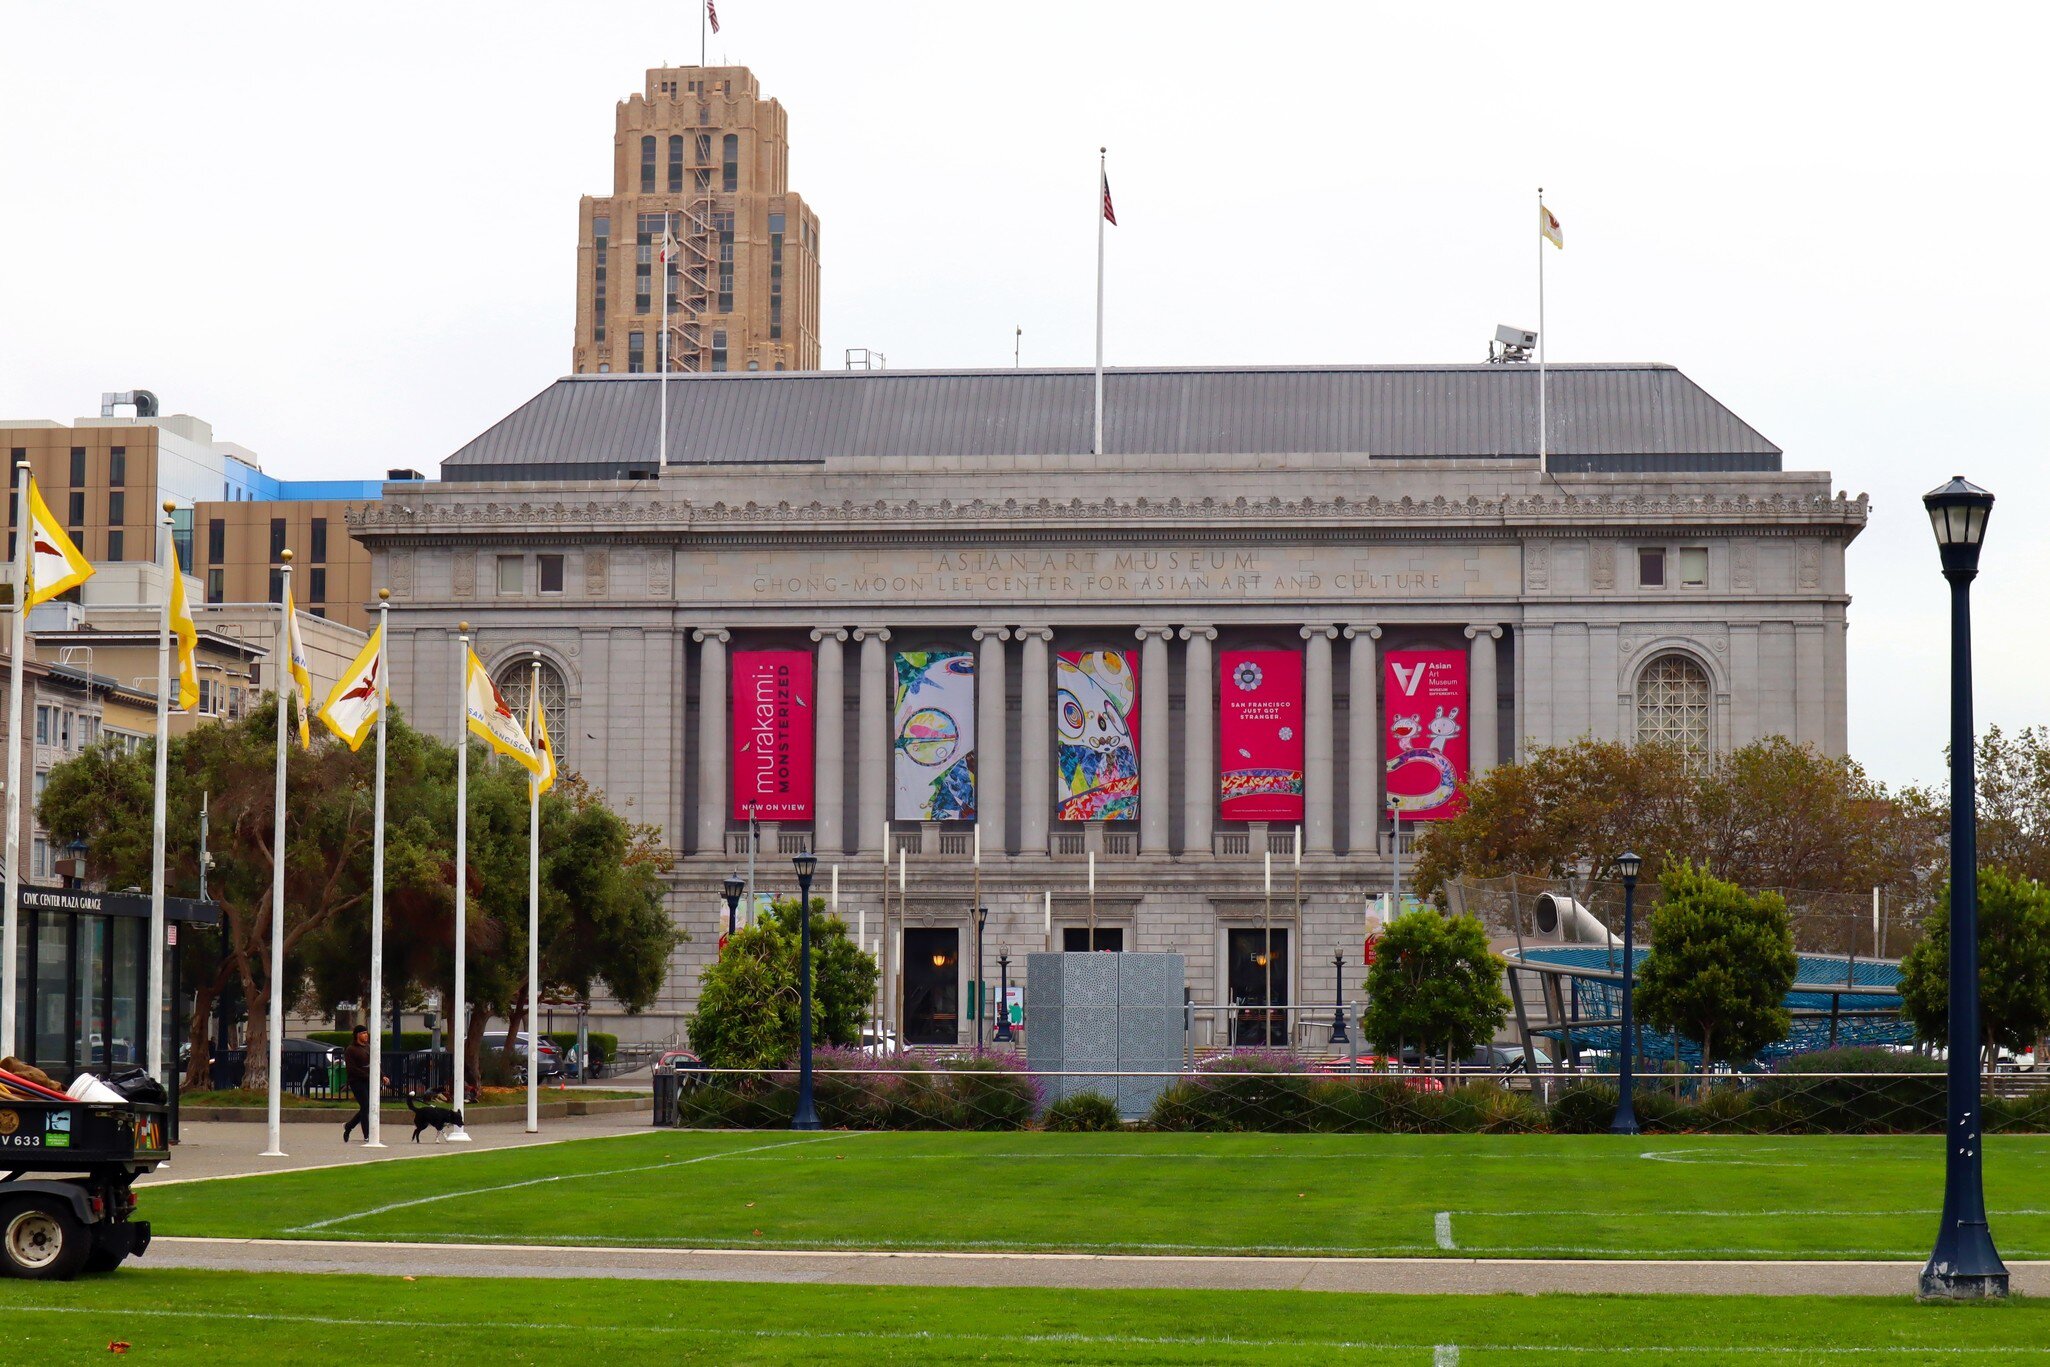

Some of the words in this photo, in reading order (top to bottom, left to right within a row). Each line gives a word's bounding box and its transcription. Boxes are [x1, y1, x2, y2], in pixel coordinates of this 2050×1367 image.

[937, 552, 1027, 571] ASIAN
[1042, 552, 1100, 571] ART
[1114, 551, 1255, 570] MUSEUM
[753, 577, 925, 593] CHONG-MOON
[938, 576, 973, 592] LEE
[986, 576, 1075, 592] CENTER
[1087, 576, 1129, 591] FOR
[1141, 576, 1210, 591] ASIAN
[1221, 575, 1262, 590] ART
[1274, 575, 1322, 590] AND
[1334, 574, 1440, 589] CULTURE
[468, 707, 485, 721] SAN
[752, 665, 774, 793] murakami:
[778, 665, 789, 793] MONSTERIZED
[23, 892, 39, 905] CIVIC
[39, 893, 61, 907] CENTER
[61, 895, 79, 908] PLAZA
[79, 897, 102, 910] GARAGE
[1, 1135, 10, 1146] V
[14, 1135, 40, 1146] 633
